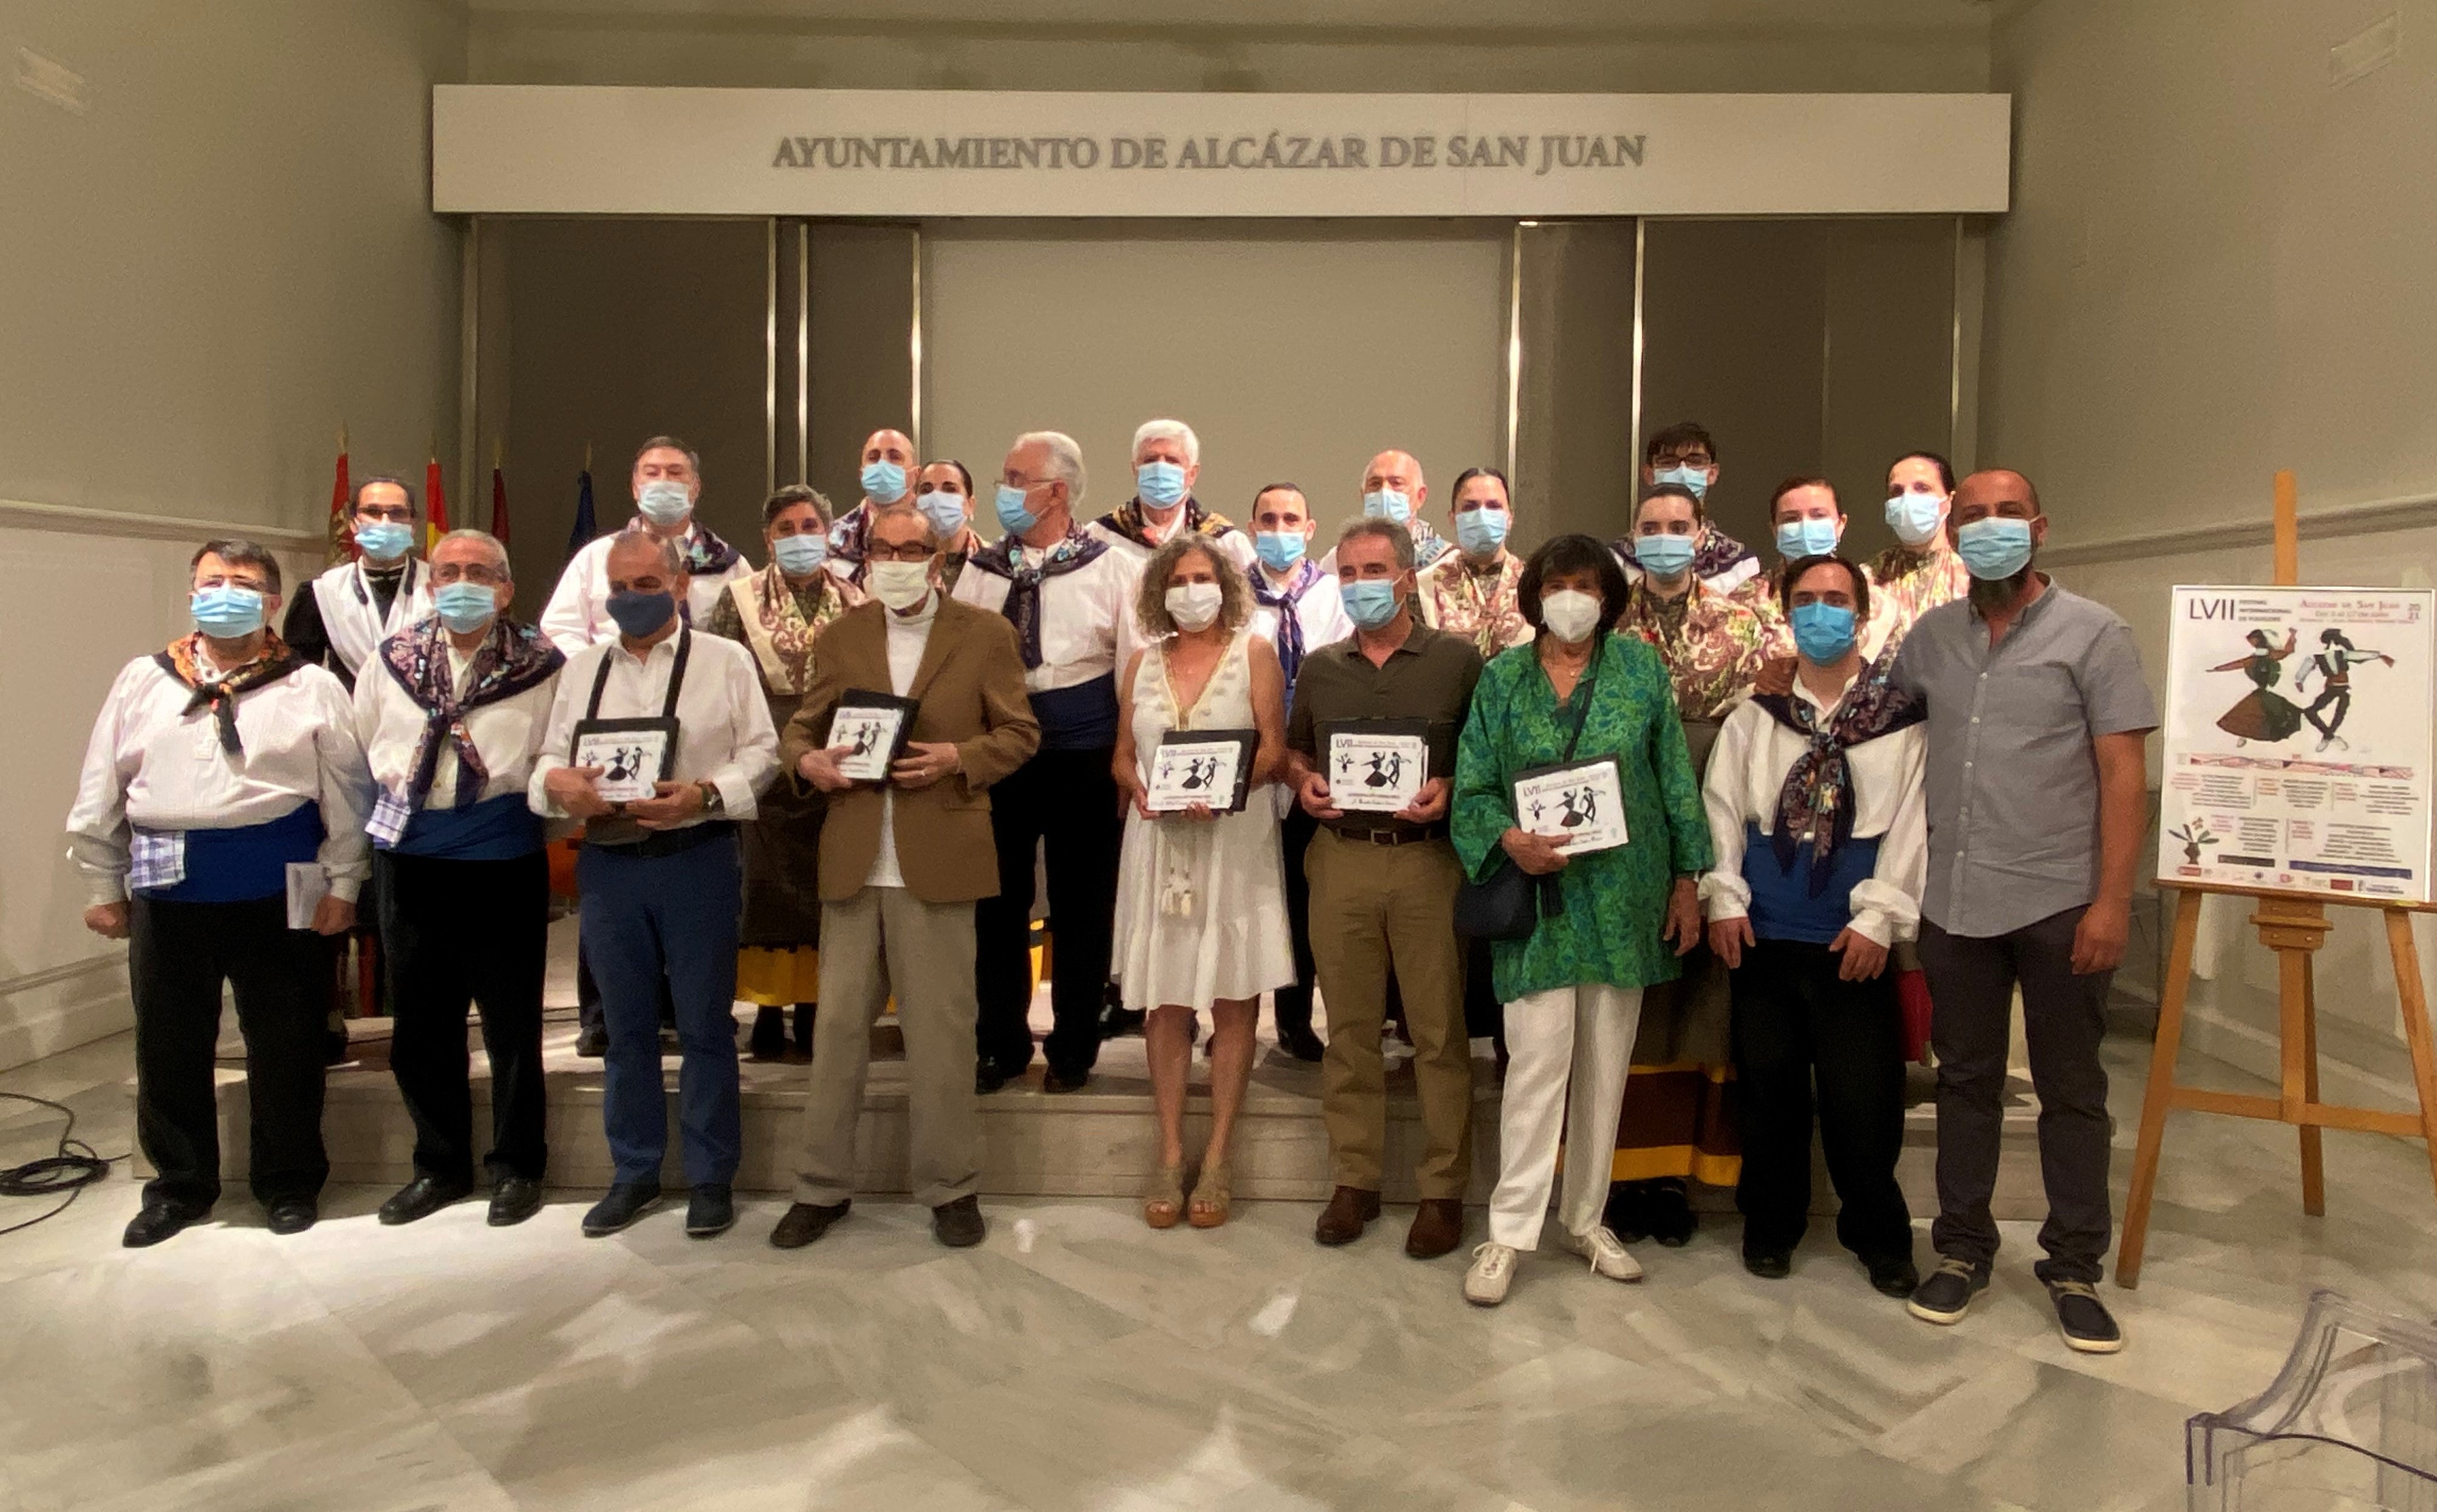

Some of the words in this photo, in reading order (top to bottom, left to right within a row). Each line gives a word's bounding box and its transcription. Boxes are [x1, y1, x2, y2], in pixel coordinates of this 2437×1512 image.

[772, 136, 1100, 169] AYUNTAMIENTO
[1110, 137, 1168, 169] DE
[1175, 128, 1370, 169] ALCÁZAR
[1378, 135, 1438, 168] DE
[1446, 135, 1530, 168] SAN
[1534, 134, 1647, 176] JUAN
[2189, 598, 2235, 621] LVII
